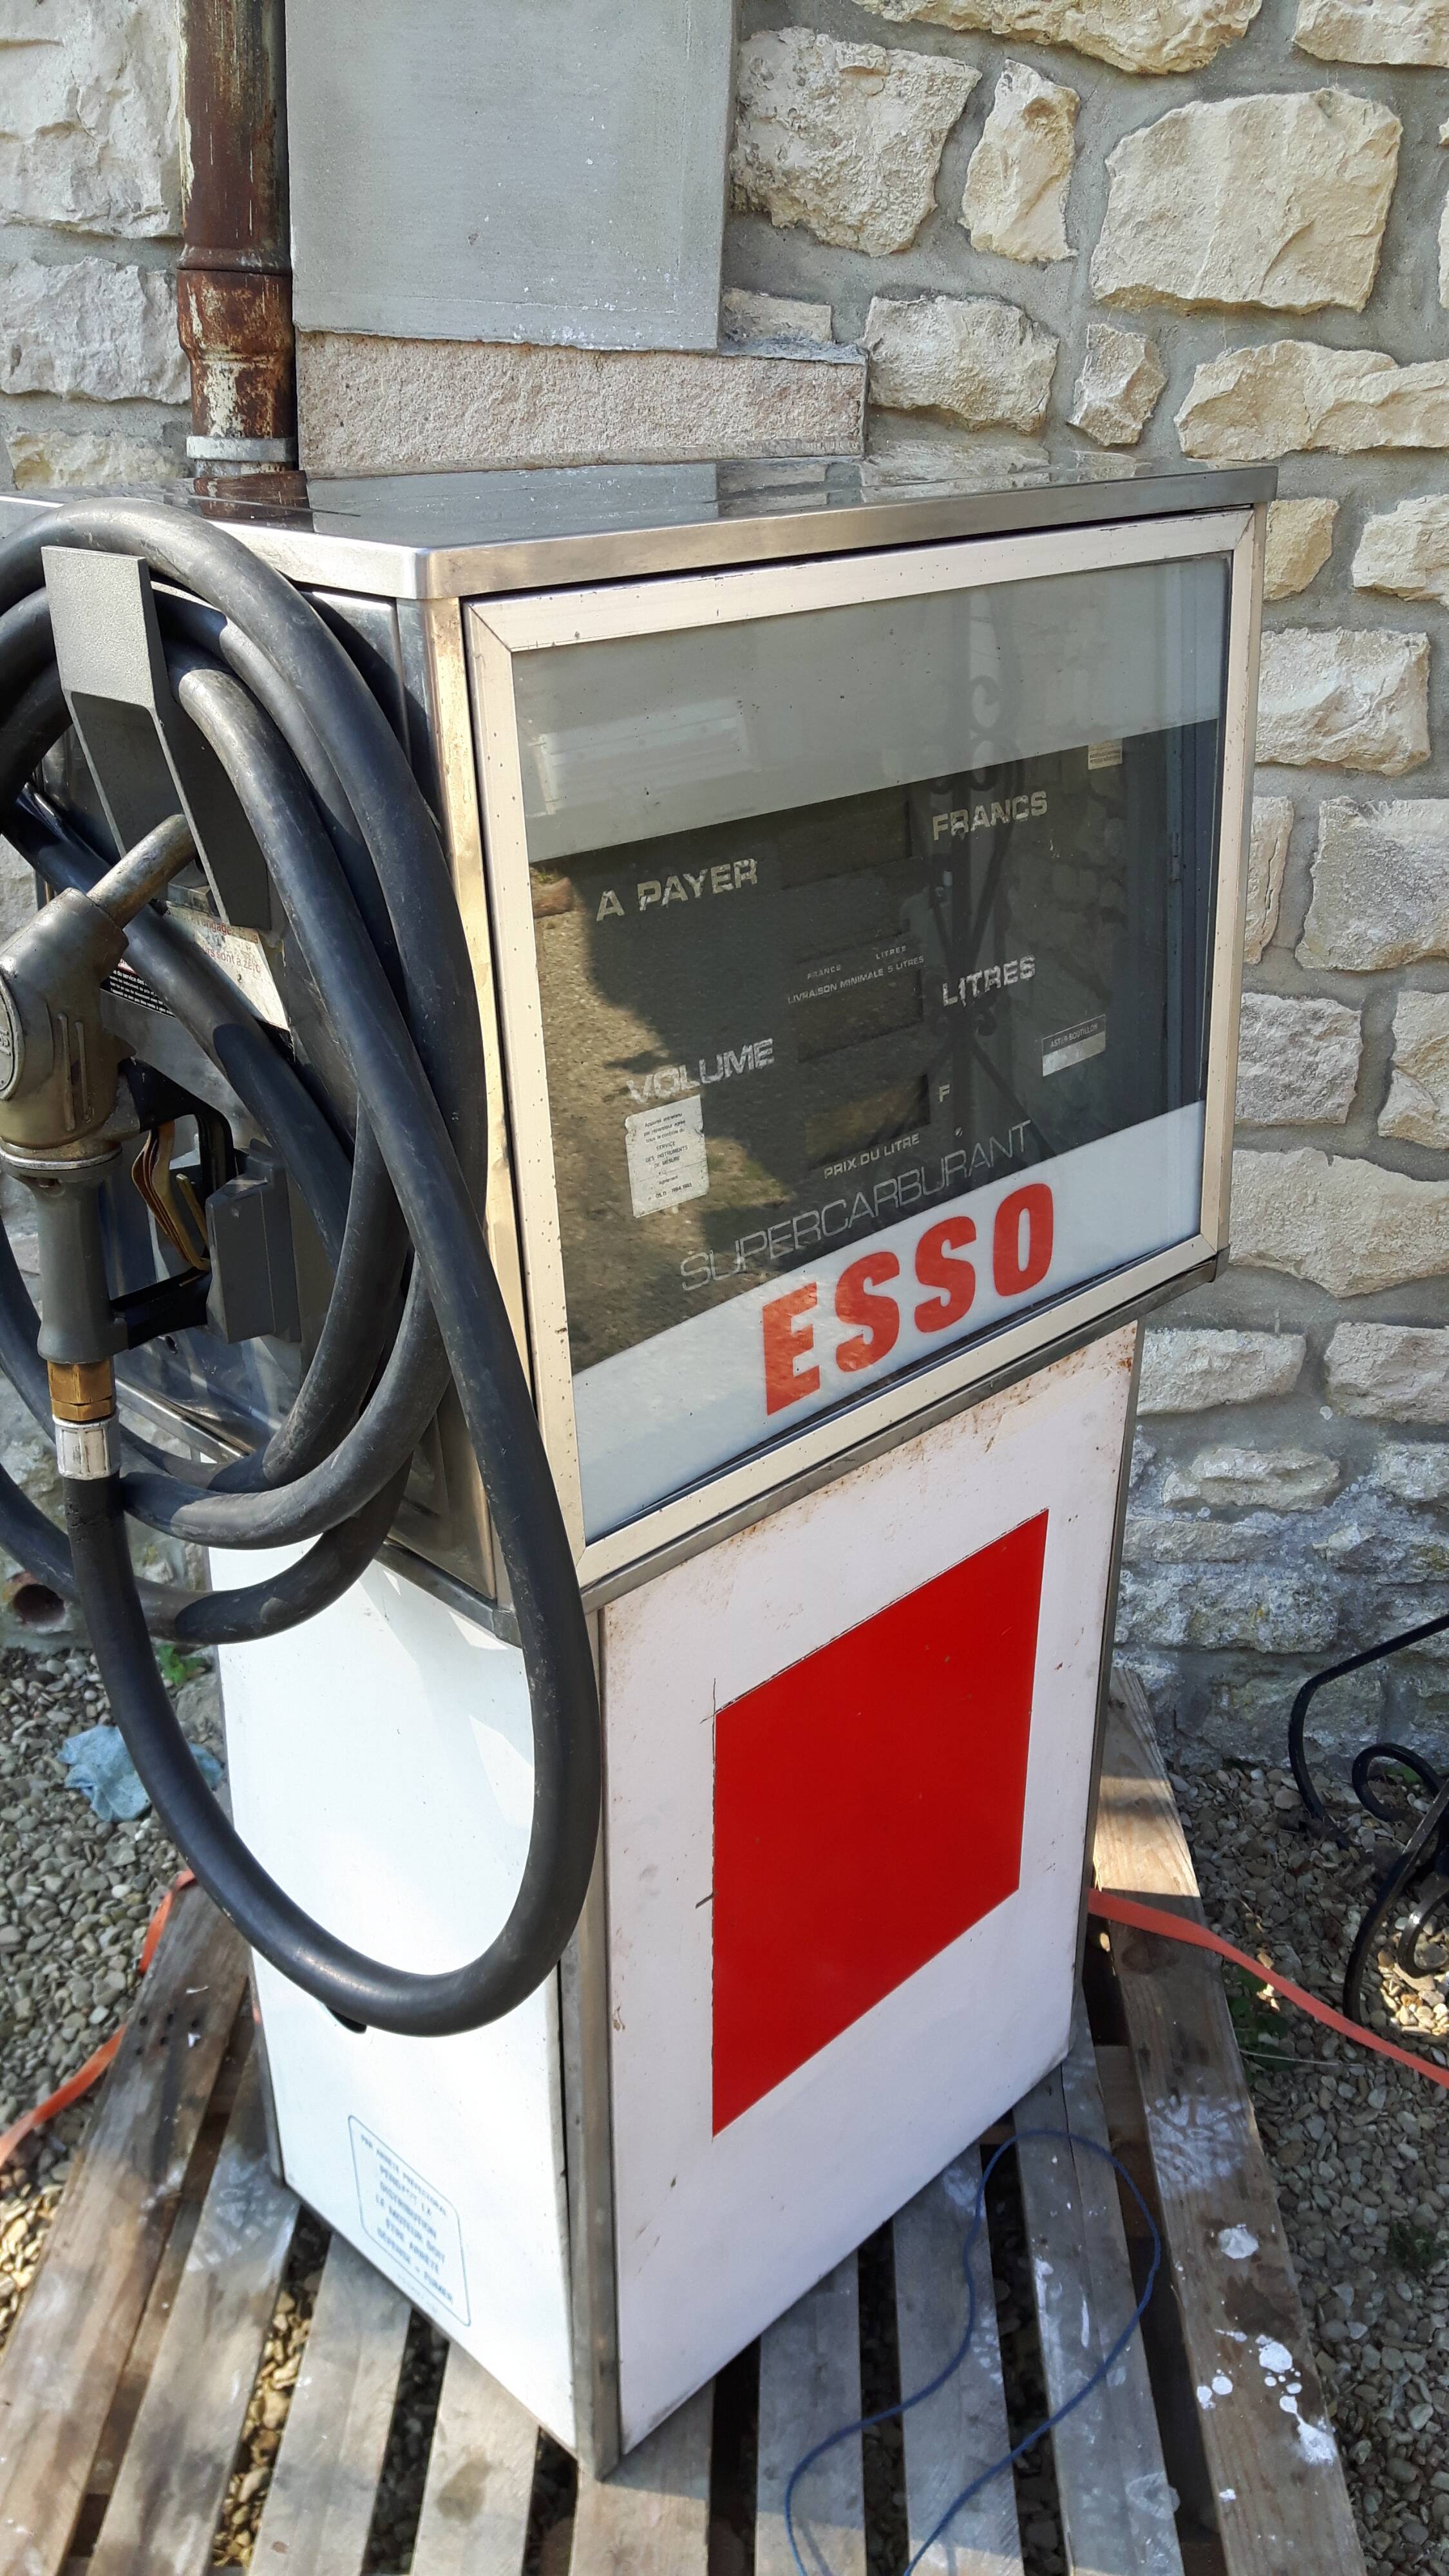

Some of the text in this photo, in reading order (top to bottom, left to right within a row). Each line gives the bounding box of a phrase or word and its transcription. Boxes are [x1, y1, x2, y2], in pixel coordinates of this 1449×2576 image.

[933, 790, 1048, 841] FRANCS
[595, 858, 758, 922] A PAYER
[806, 964, 842, 980] FRANCS
[875, 945, 907, 960] LITRES
[788, 983, 837, 1004] LIVRAISON
[840, 968, 884, 988] MINIMALE
[896, 955, 924, 971] LITRES
[942, 955, 1036, 1007] LITRES
[626, 1037, 774, 1104] VOLUME
[939, 1084, 950, 1103] F
[824, 1133, 920, 1179] PRIX DU LITRE
[681, 1119, 1031, 1292] SUPERCARBURANT
[762, 1182, 1054, 1416] ESSO
